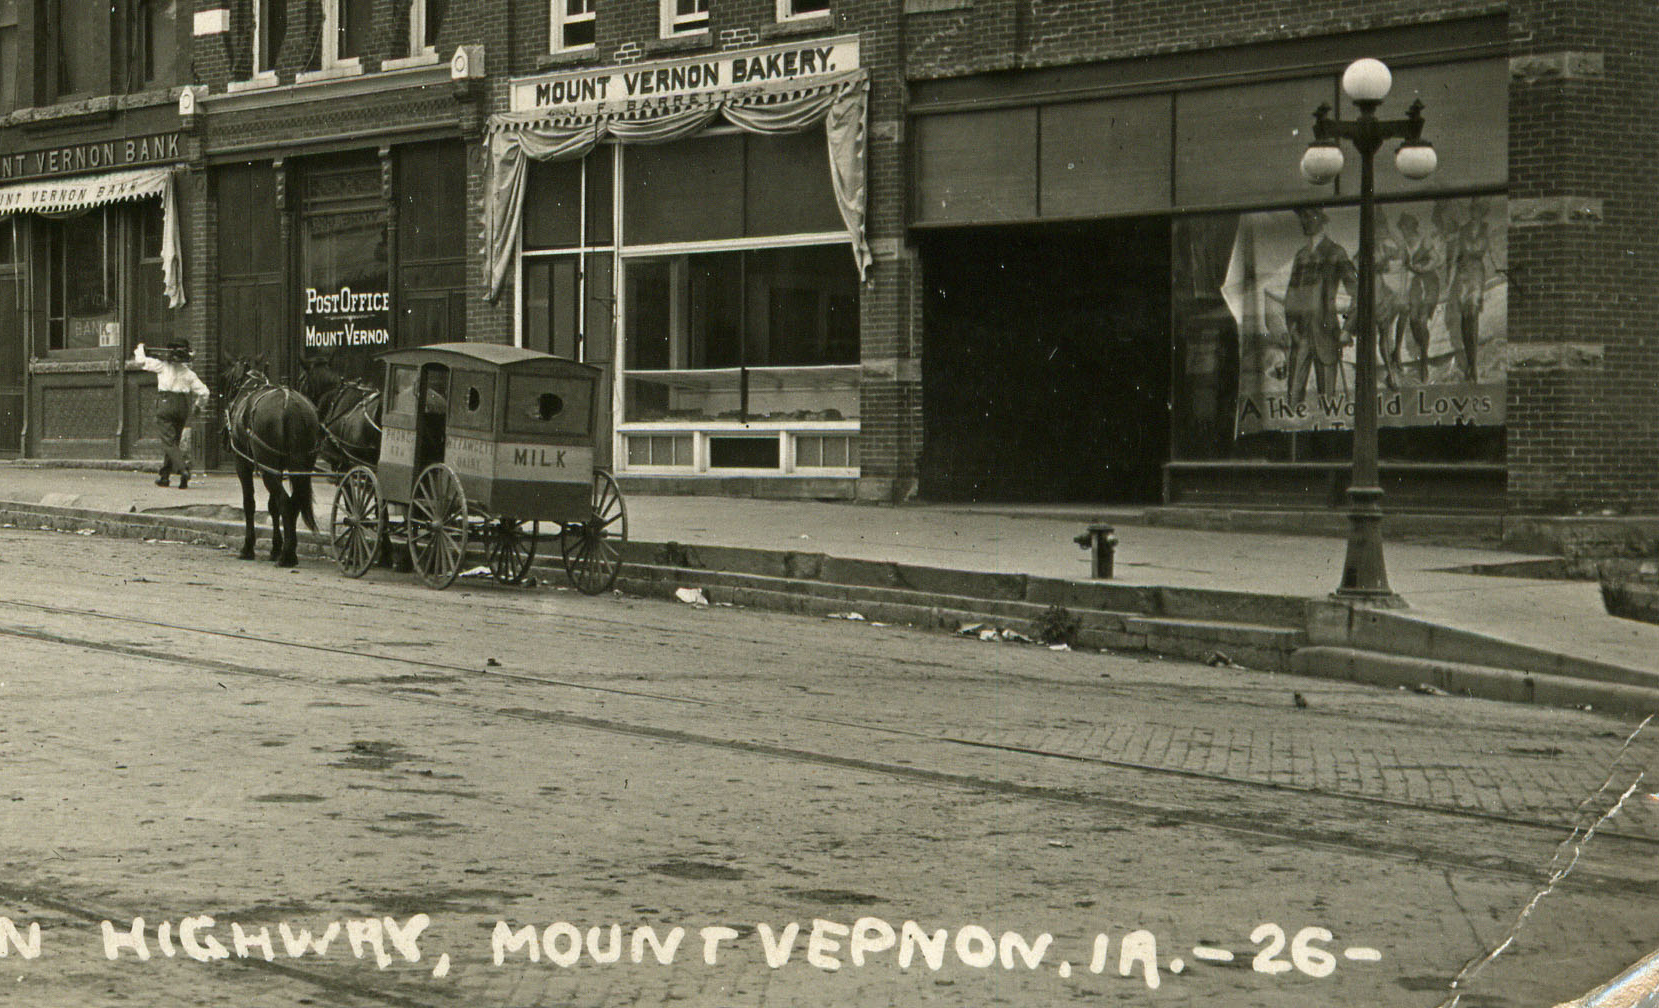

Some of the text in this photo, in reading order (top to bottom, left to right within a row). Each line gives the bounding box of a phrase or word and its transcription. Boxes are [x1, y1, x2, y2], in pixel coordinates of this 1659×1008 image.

[535, 46, 836, 107] MOUNT VERNON BAKERY.
[626, 90, 732, 111] BARRETT
[36, 143, 115, 173] VERNON
[126, 134, 179, 162] BANK
[32, 188, 88, 203] VERNON
[96, 181, 138, 199] BANK
[305, 287, 389, 314] POST OFFICE
[305, 325, 344, 347] MOUNT
[1321, 393, 1402, 418] Wold
[1418, 392, 1491, 415] Loves
[514, 448, 567, 468] MILK
